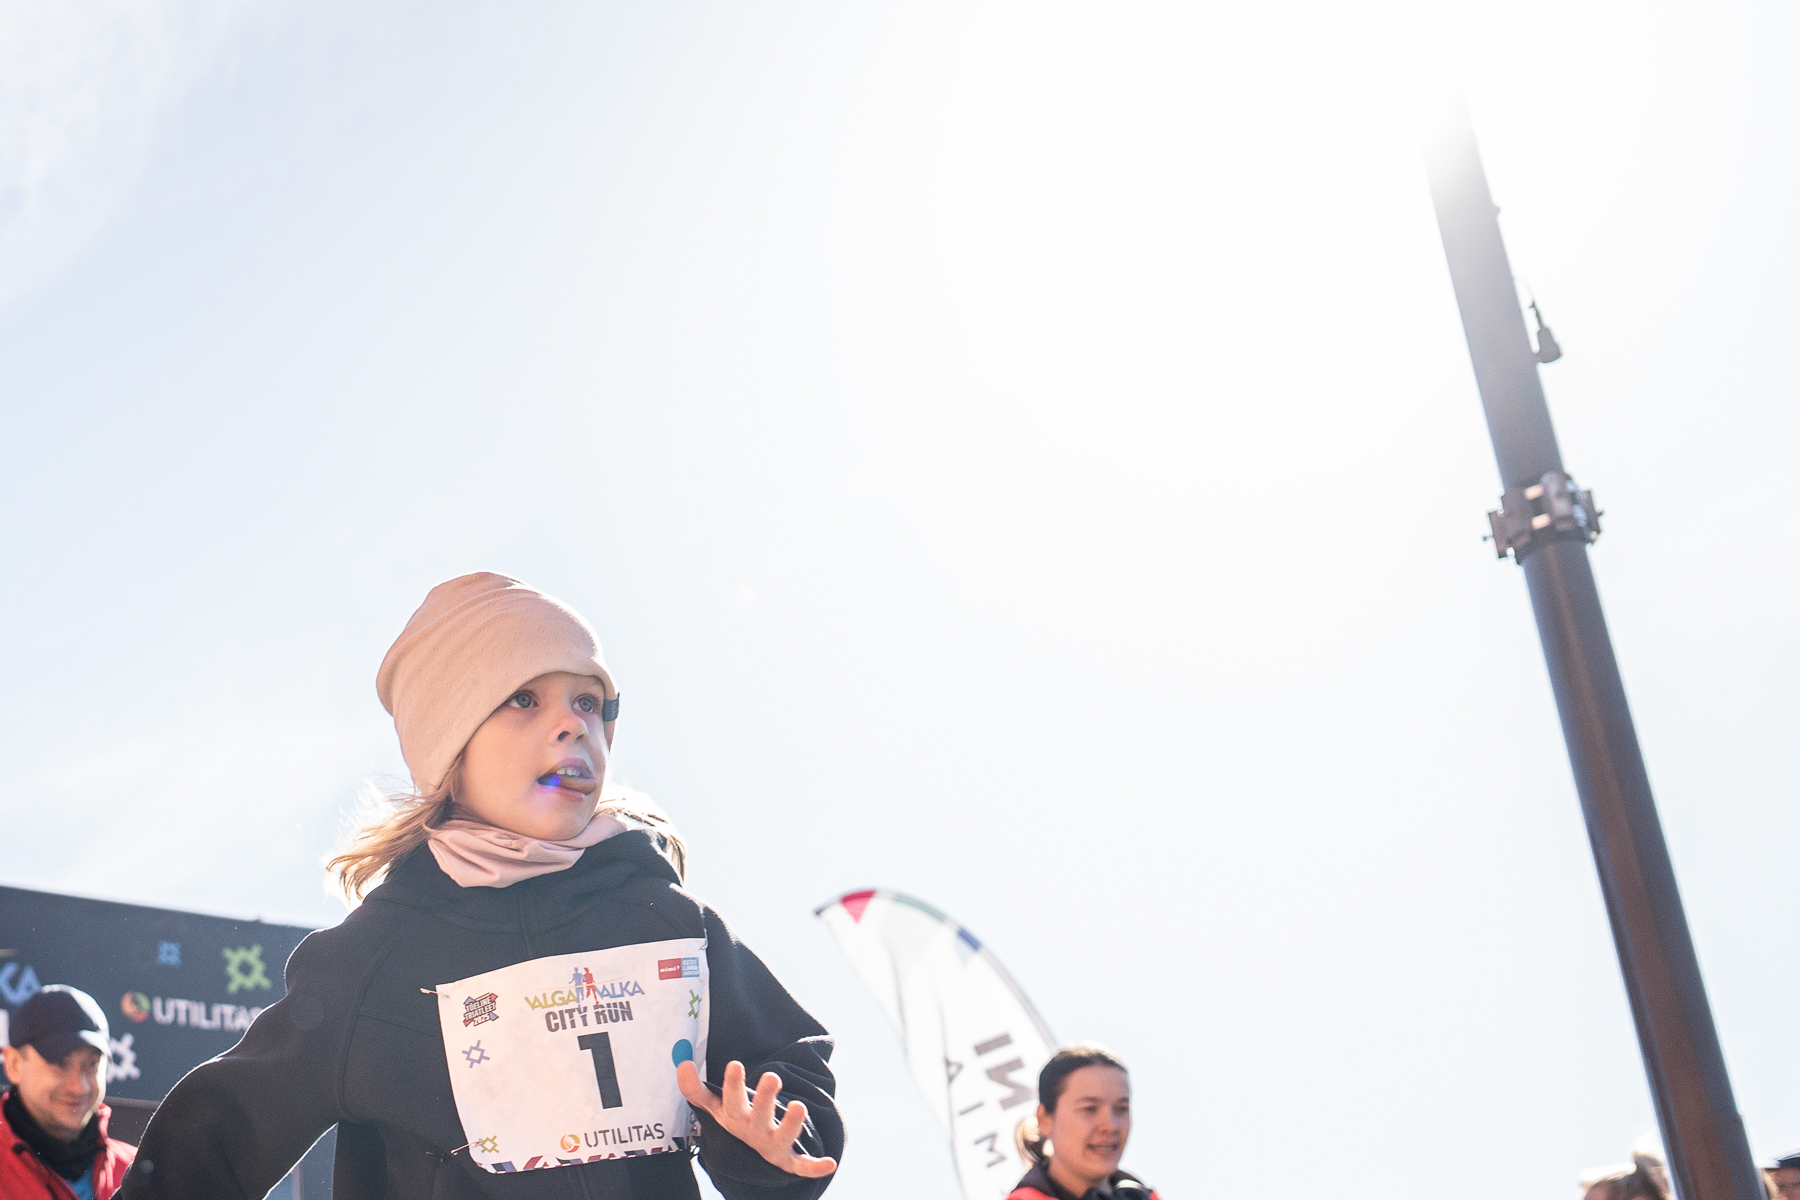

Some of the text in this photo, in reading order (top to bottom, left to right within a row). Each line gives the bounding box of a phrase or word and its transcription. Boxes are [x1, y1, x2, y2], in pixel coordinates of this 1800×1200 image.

[524, 986, 578, 1011] VALGA
[545, 1000, 634, 1033] CITY RUN
[577, 1031, 623, 1109] 1
[584, 1122, 665, 1148] UTILITAS
